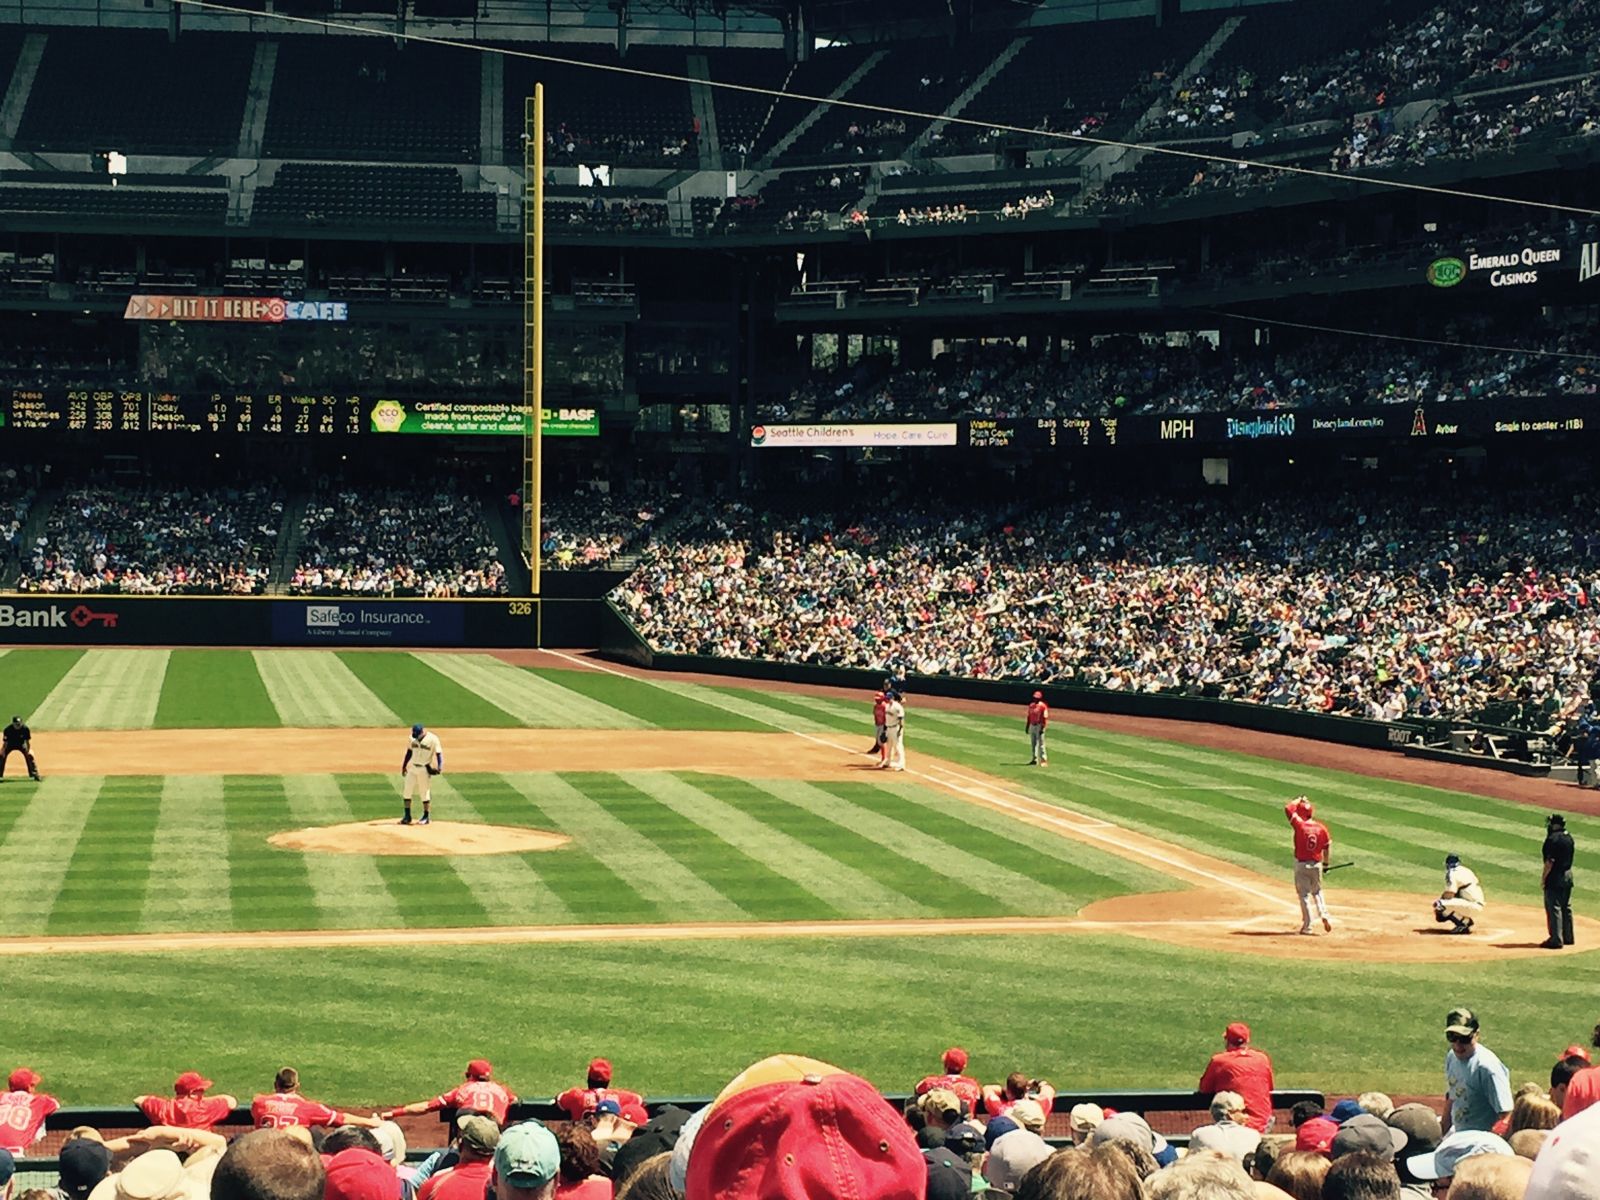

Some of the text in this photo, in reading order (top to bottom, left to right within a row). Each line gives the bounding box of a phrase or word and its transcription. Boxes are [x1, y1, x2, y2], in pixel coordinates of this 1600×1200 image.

[1470, 248, 1560, 270] EMERALD QUEEN
[1490, 271, 1537, 287] CASINOS
[173, 300, 347, 320] HIT IT HERE CAFE
[152, 402, 179, 413] Today
[415, 402, 452, 412] Certified
[453, 403, 510, 413] compostable
[152, 412, 185, 421] Season
[297, 415, 308, 423] 27
[424, 412, 449, 421] made
[451, 412, 472, 421] from
[559, 409, 596, 420] BASF
[480, 422, 497, 430] and
[771, 426, 854, 438] Seattle Children's
[1161, 420, 1194, 439] MPH
[1521, 421, 1531, 432] to
[509, 602, 532, 615] 326
[0, 605, 67, 627] Bank
[310, 608, 424, 624] Safeco Insurance
